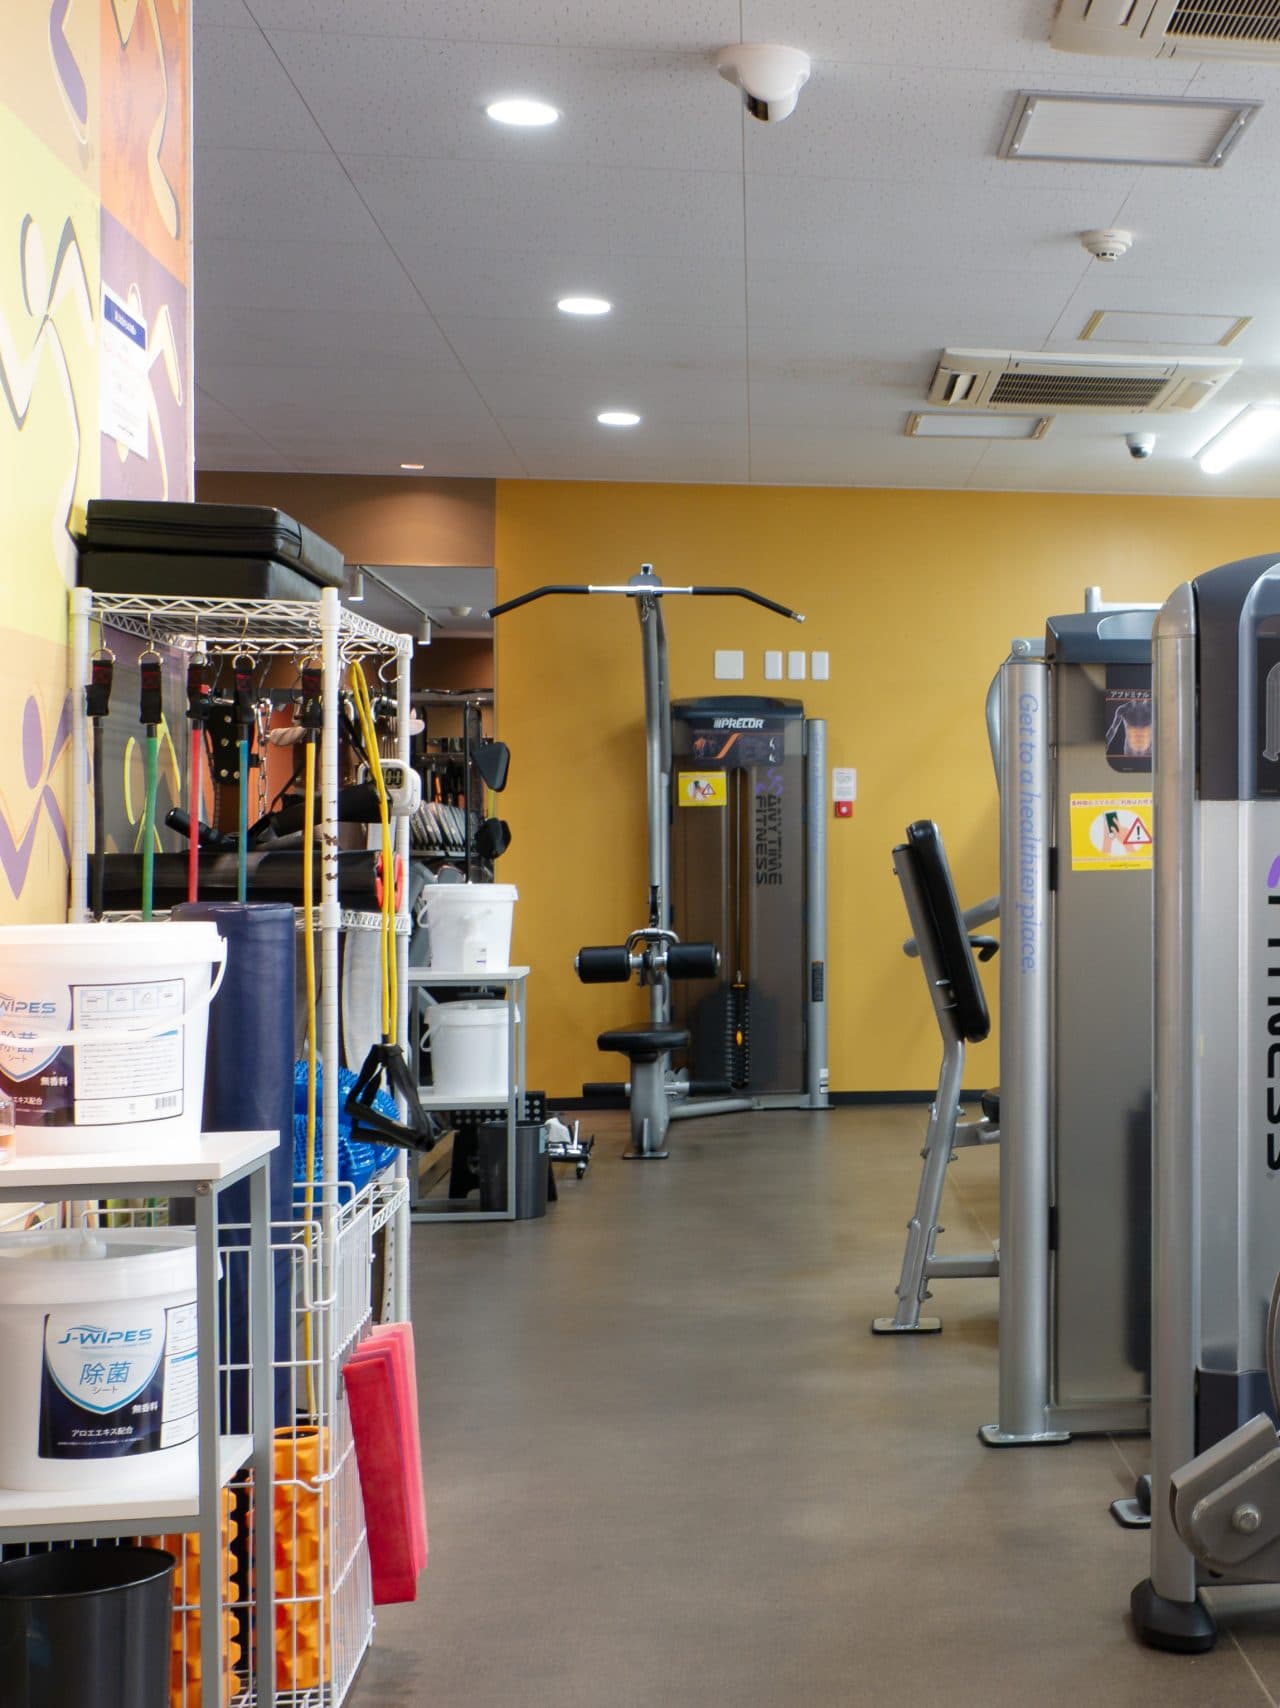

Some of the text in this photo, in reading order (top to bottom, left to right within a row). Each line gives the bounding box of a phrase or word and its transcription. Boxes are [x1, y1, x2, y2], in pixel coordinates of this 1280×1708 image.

[1020, 694, 1039, 736] Get
[1020, 742, 1036, 764] to
[1020, 770, 1033, 784] a
[1020, 791, 1041, 898] healthier
[58, 1328, 152, 1345] J-WIPES
[80, 1360, 132, 1385] 除菌
